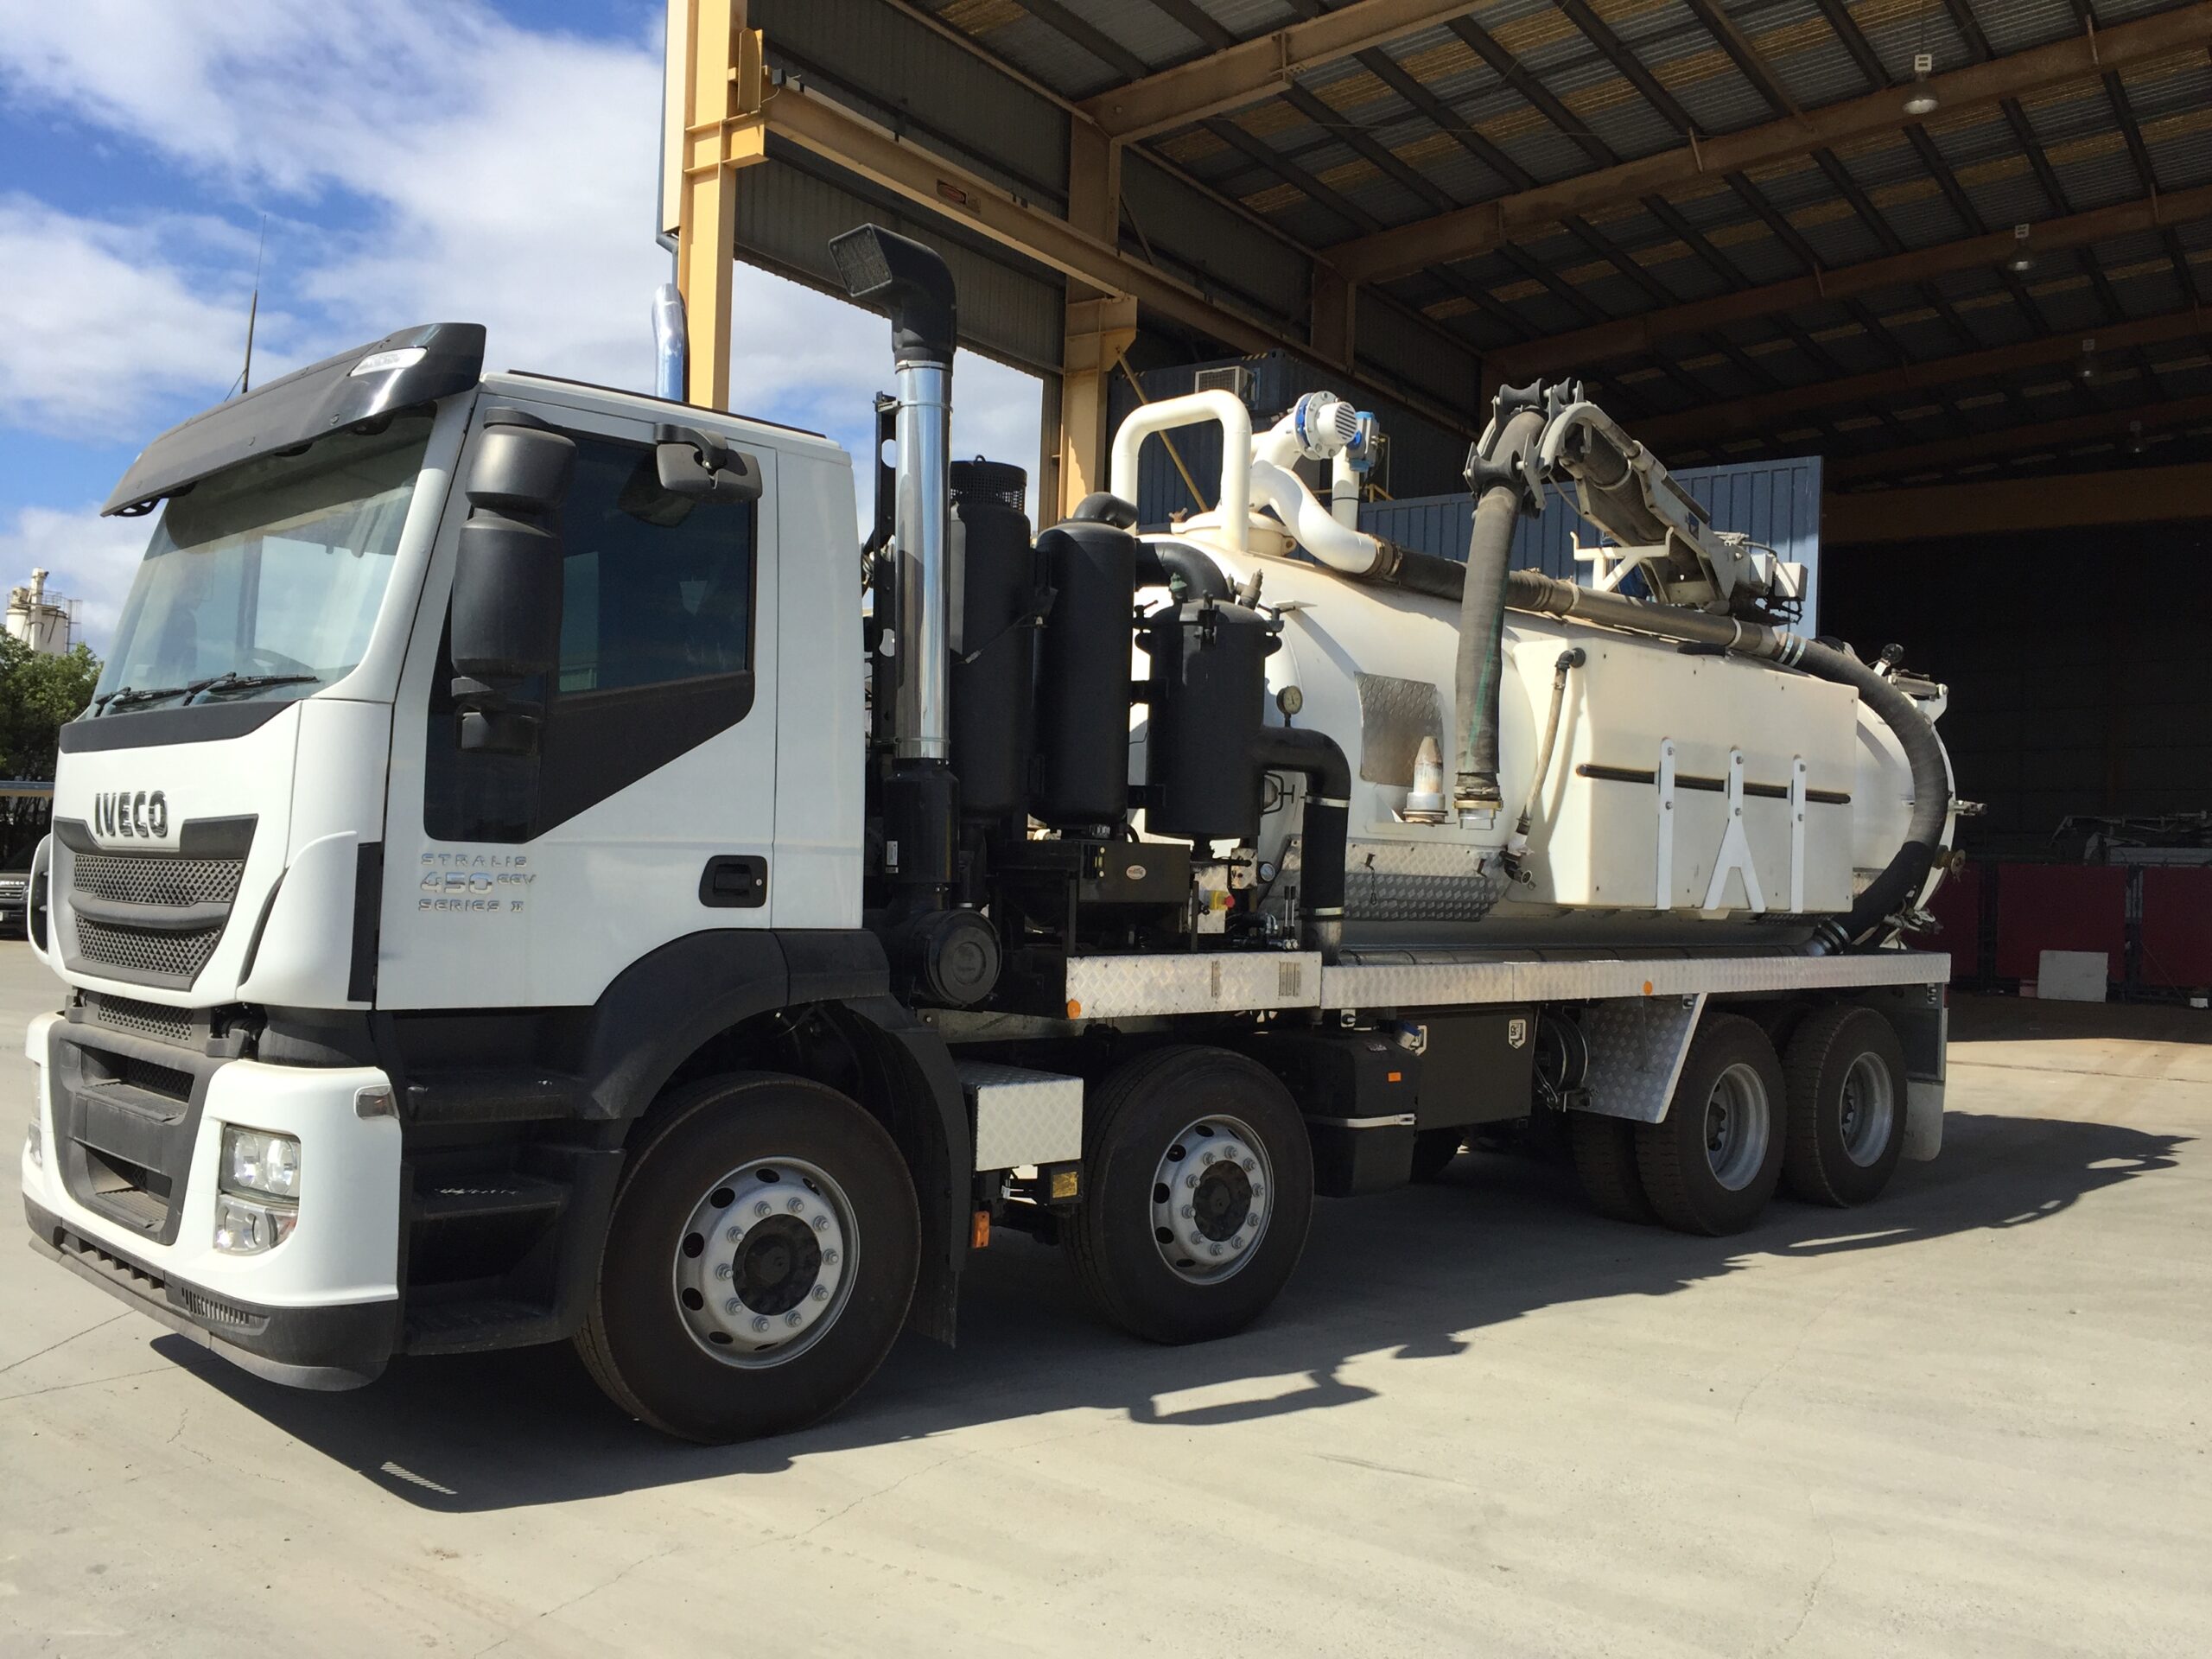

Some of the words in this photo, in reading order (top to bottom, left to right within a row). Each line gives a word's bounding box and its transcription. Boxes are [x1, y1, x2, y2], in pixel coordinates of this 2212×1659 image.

[94, 790, 168, 837] IVECO
[421, 853, 527, 868] STRALIS
[418, 899, 500, 912] SERIES
[511, 900, 524, 912] II
